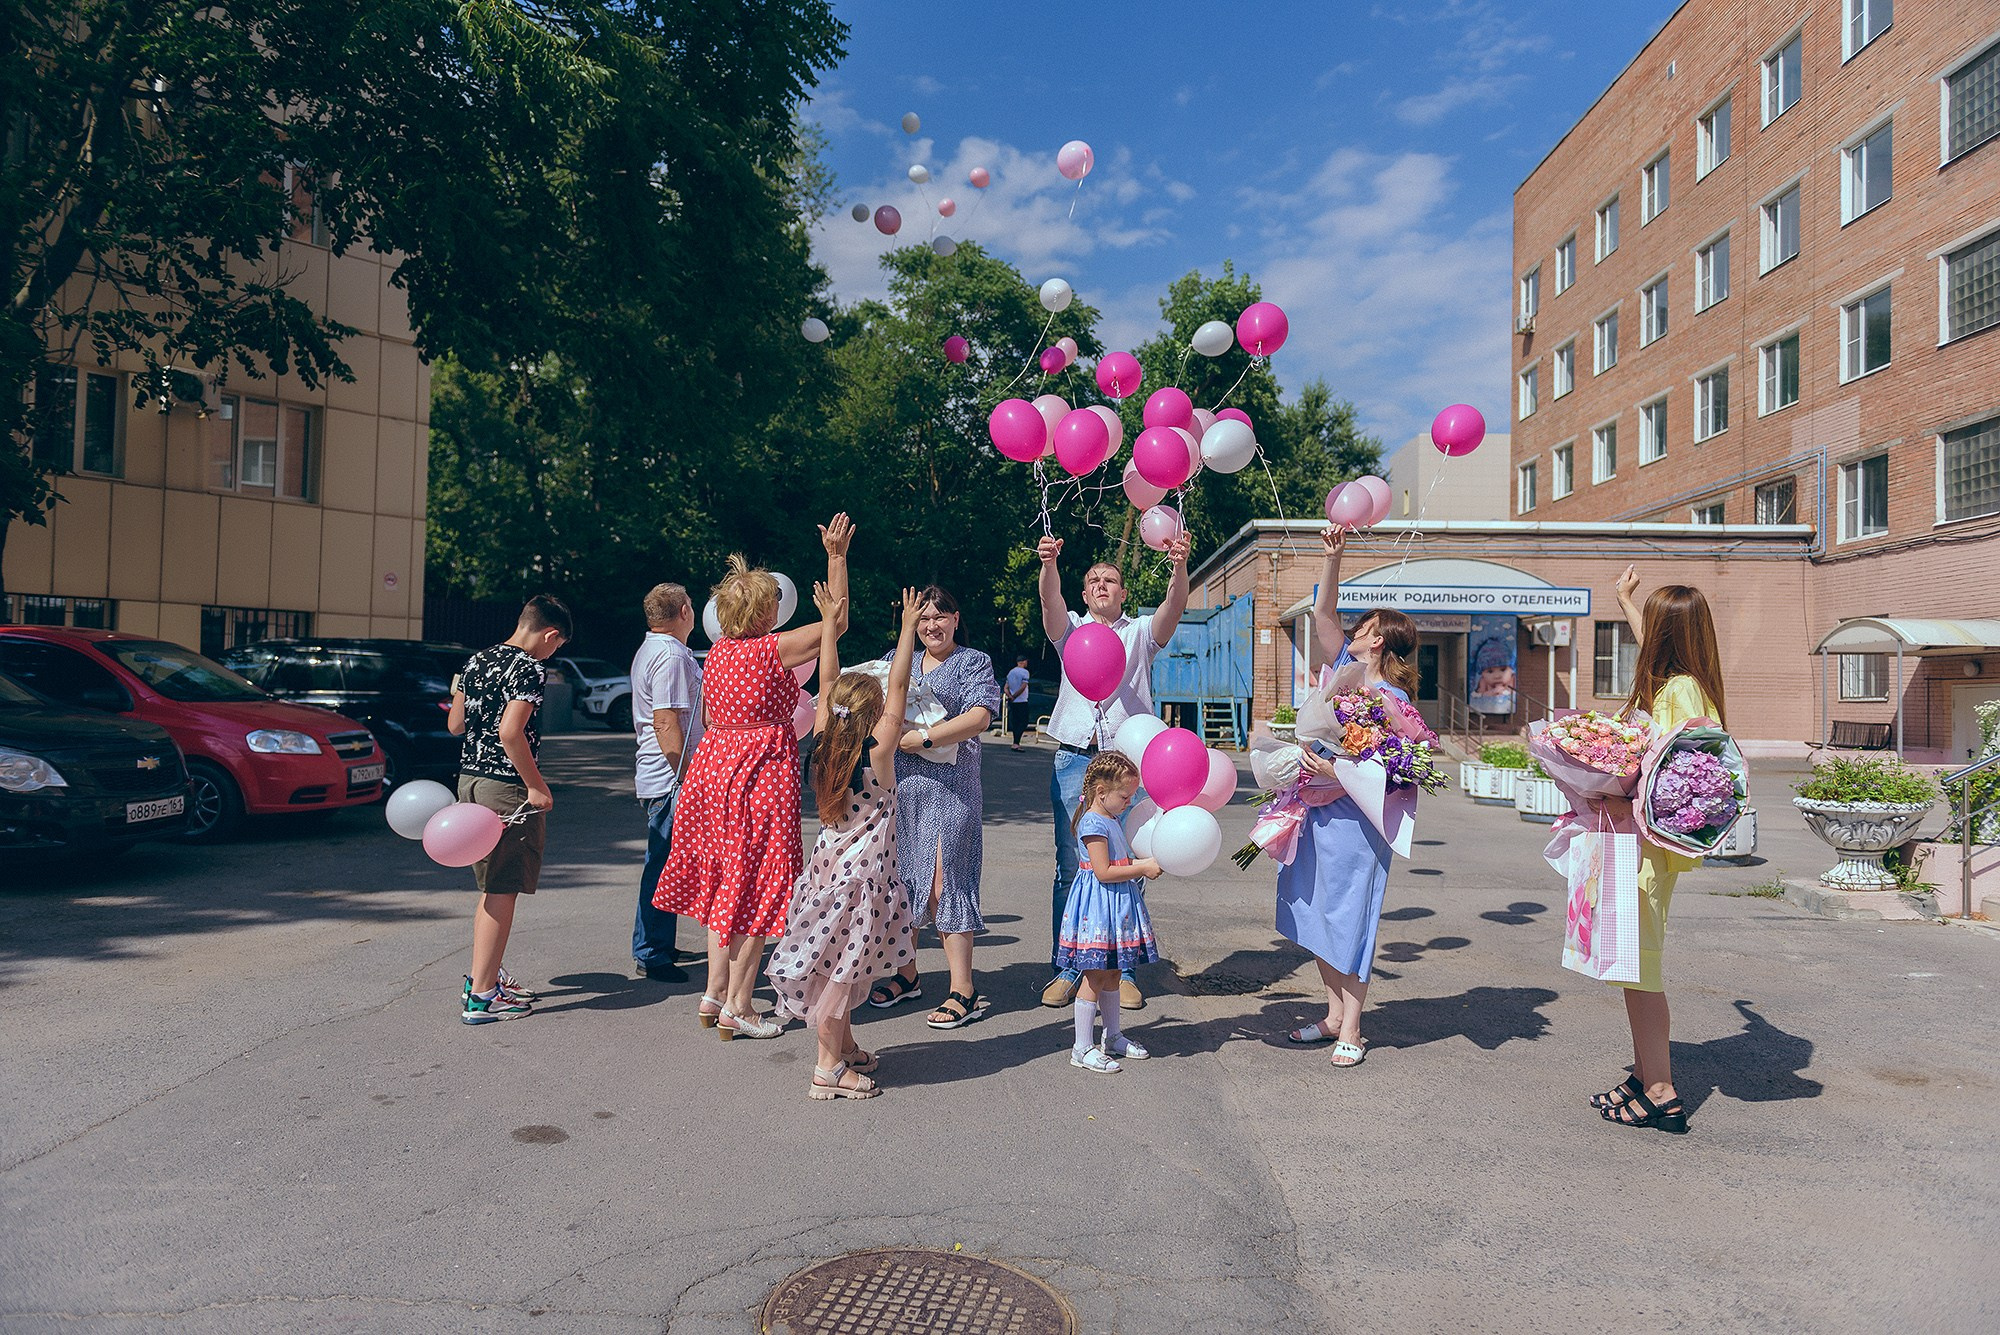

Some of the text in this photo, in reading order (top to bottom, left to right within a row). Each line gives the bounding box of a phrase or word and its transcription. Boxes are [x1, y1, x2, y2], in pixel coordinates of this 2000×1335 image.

[1338, 591, 1582, 606] РИЕМНИК РОДИЛЬНОГО ОТДЕЛЕНИЯ
[169, 798, 183, 810] 161
